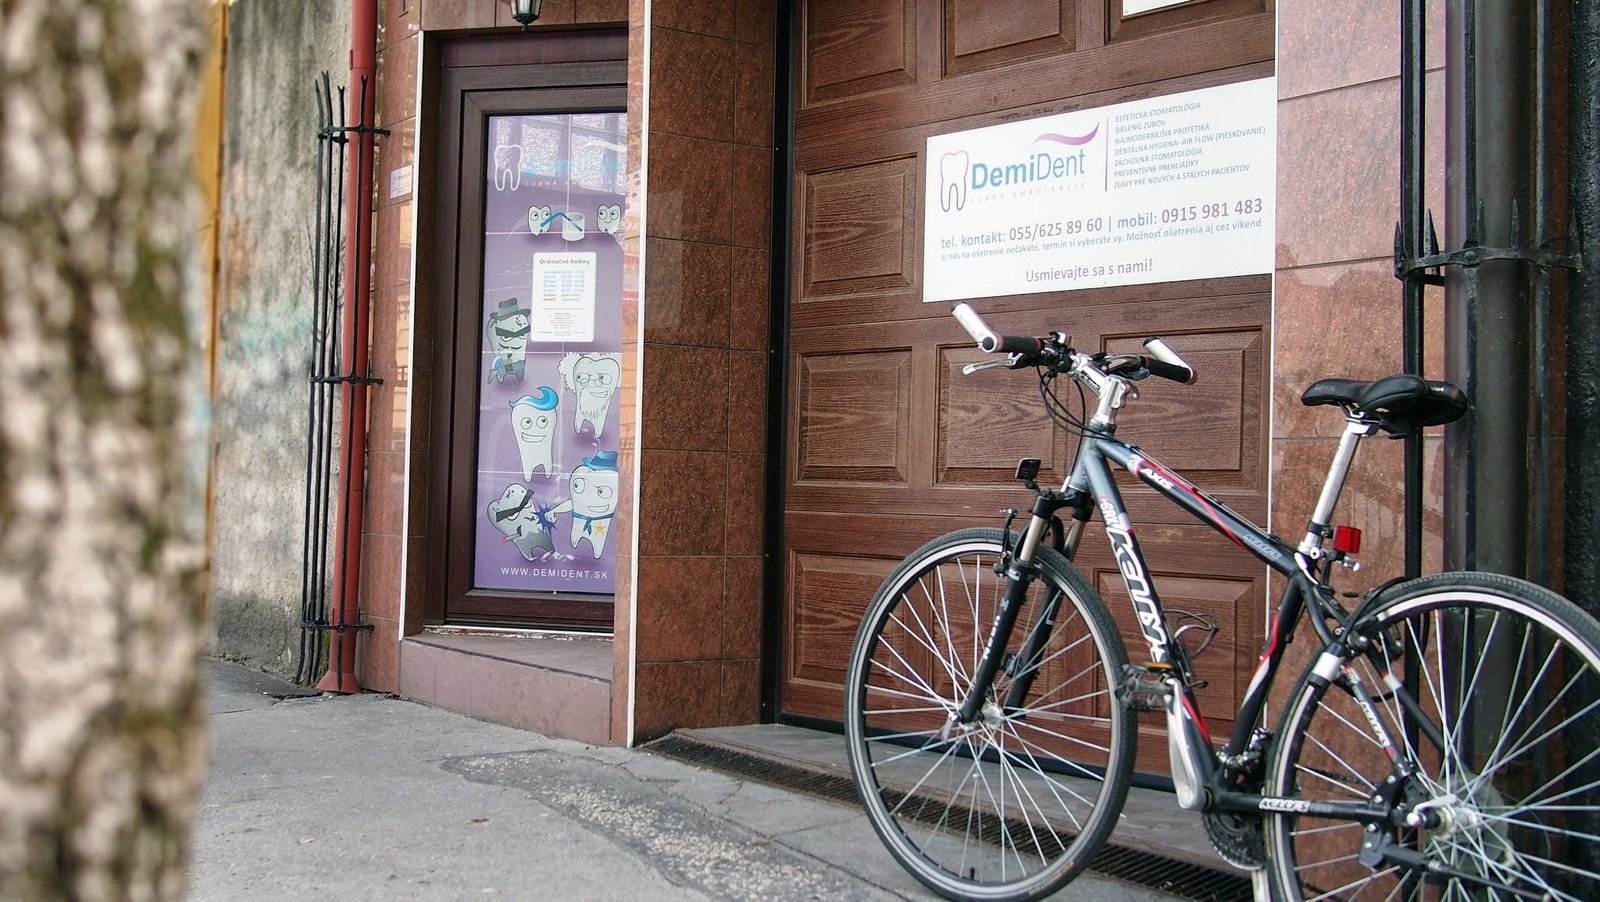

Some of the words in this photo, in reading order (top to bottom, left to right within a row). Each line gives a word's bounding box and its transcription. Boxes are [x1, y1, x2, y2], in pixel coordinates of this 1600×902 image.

[1115, 123, 1142, 134] BIELENIE
[1173, 123, 1210, 136] PROTETIKA
[1181, 137, 1193, 146] AIR
[1194, 134, 1214, 143] FLOW
[971, 149, 1085, 190] DemiDent
[1158, 160, 1200, 172] PREHLIADKY
[1134, 178, 1146, 187] PRE
[941, 236, 958, 249] tel.
[961, 231, 1006, 247] kontakt:
[1009, 222, 1062, 241] 055/625
[1066, 219, 1082, 235] 89
[1086, 217, 1103, 233] 60
[1117, 211, 1157, 229] mobil:
[1161, 206, 1197, 224] 0915
[1202, 202, 1229, 219] 981
[1234, 198, 1263, 215] 483
[1069, 239, 1076, 248] si
[1113, 235, 1124, 244] vy.
[1205, 224, 1214, 234] aj
[1215, 222, 1230, 232] cez
[1025, 264, 1089, 282] Usmievajte
[1092, 266, 1105, 277] sa
[1108, 264, 1114, 275] s
[1117, 258, 1153, 274] nami!
[1139, 467, 1176, 491] AXIS
[500, 567, 609, 580] WWW.DEMIDENT.SK
